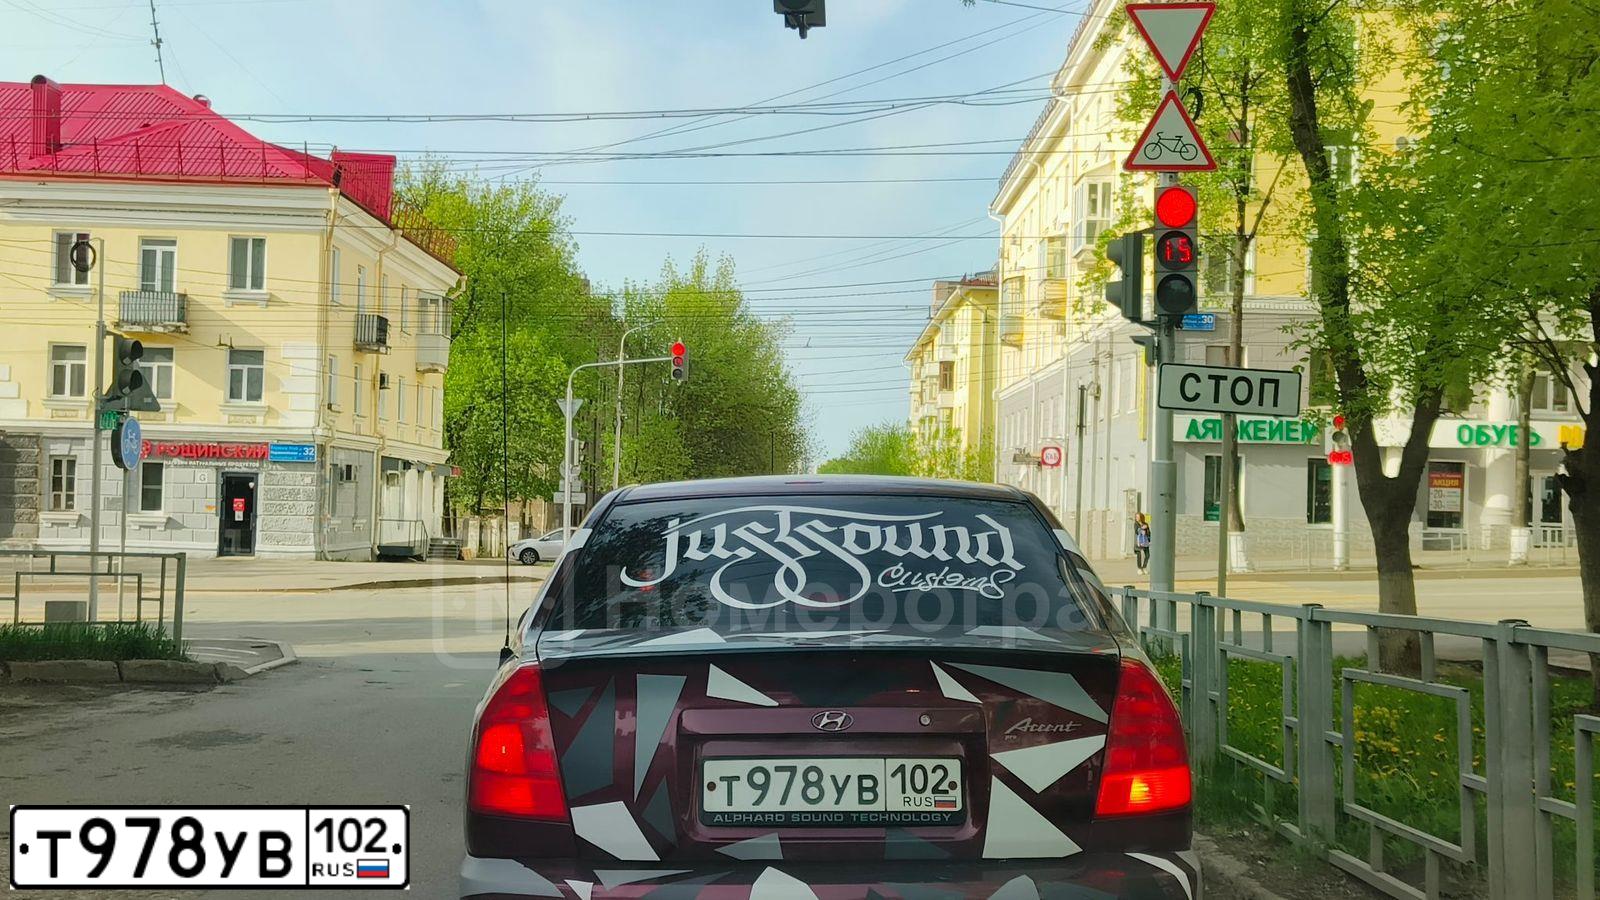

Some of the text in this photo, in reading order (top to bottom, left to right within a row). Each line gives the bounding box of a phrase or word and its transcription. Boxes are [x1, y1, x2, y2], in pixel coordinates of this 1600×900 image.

[1165, 237, 1192, 263] 15
[1201, 315, 1214, 324] 30
[1180, 372, 1280, 408] СТОП
[1457, 424, 1540, 446] ОБУВЬ
[156, 441, 268, 460] РОЩИНСКИЙ
[303, 447, 315, 456] 32
[1004, 717, 1082, 735] Accent
[890, 763, 949, 794] 102
[903, 796, 933, 807] RUS
[713, 812, 952, 822] ALPHARD SOUND TECHNOLOGY
